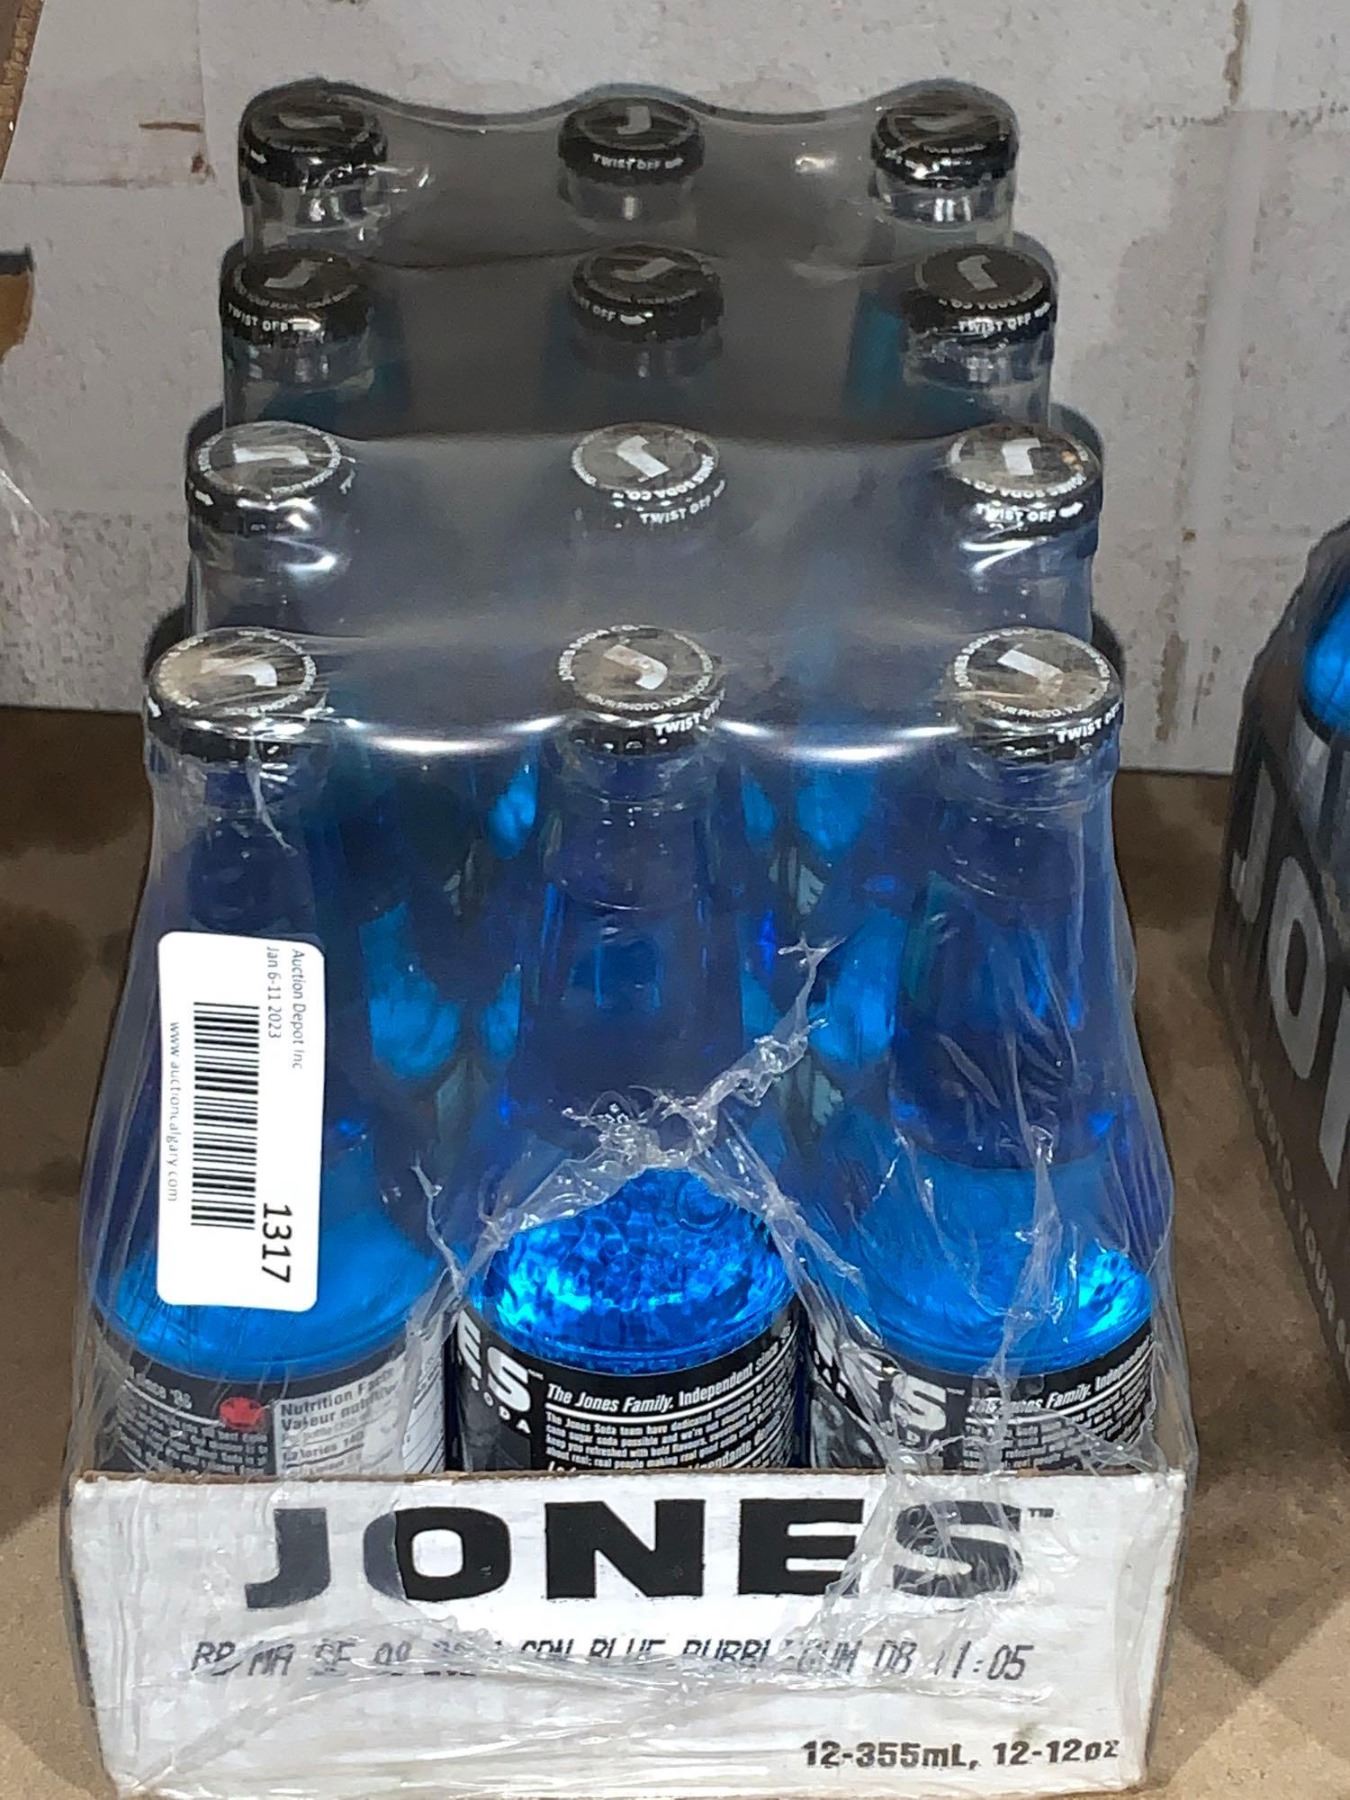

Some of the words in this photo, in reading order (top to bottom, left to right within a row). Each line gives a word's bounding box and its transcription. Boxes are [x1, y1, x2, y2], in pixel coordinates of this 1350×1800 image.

[639, 507, 688, 525] TWIST
[974, 502, 1025, 523] TWIST
[1026, 508, 1057, 523] OFF
[653, 711, 702, 737] TWIST
[1055, 717, 1103, 744] TWIST
[266, 946, 280, 968] Jan
[267, 970, 282, 1001] 6-11
[290, 948, 307, 998] Auction
[267, 1004, 282, 1039] 2023
[290, 1001, 306, 1043] Depot
[291, 1048, 304, 1070] Inc
[260, 1202, 293, 1284] 1317
[546, 1382, 574, 1405] The
[574, 1391, 620, 1413] Jones
[621, 1393, 675, 1414] Family.
[678, 1362, 754, 1407] Independent
[1045, 1383, 1093, 1409] Family.
[280, 1389, 354, 1417] Nutrition
[281, 1411, 336, 1432] Valeur
[244, 1498, 1025, 1609] JONES
[800, 1739, 979, 1771] 12-355mL,
[992, 1738, 1121, 1767] 12-12oz
